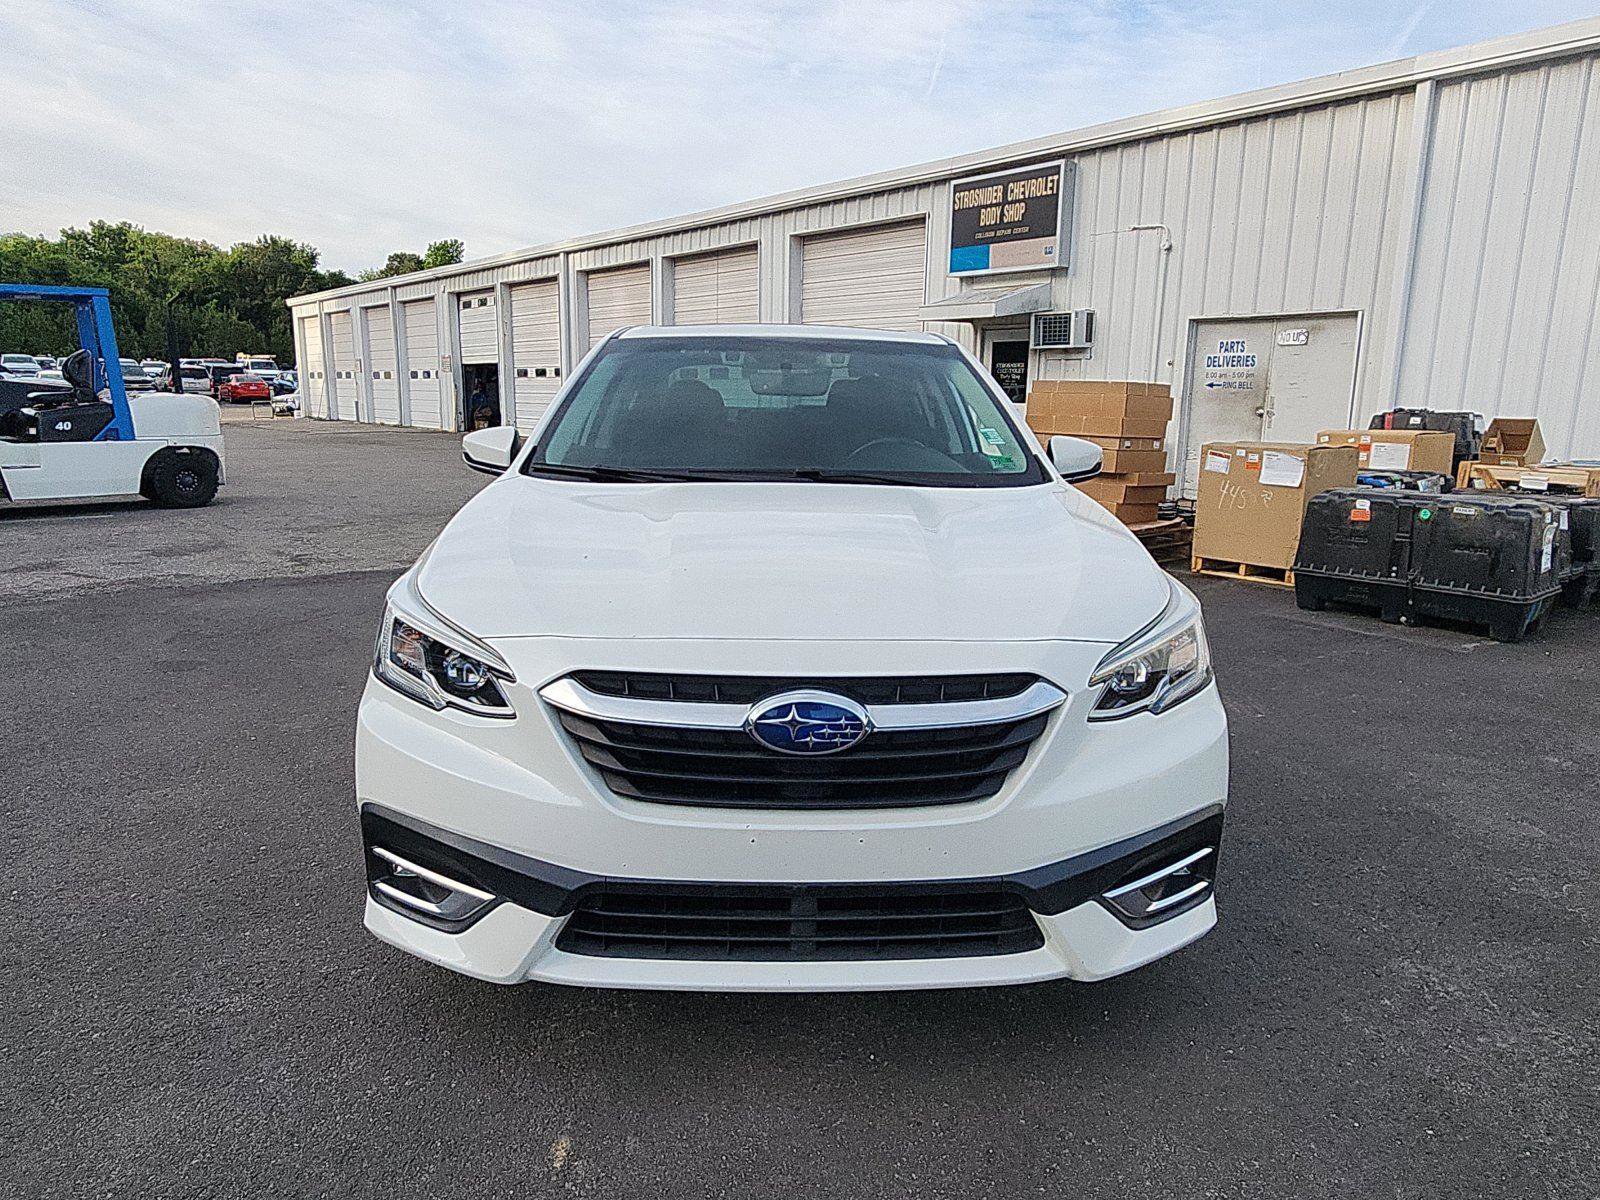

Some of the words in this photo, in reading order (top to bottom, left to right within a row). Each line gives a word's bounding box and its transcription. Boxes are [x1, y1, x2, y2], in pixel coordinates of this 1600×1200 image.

[954, 185, 1004, 211] STROSNIDER
[1007, 175, 1059, 202] CHEVROLET
[980, 205, 1002, 227] BODY
[1003, 202, 1026, 224] SHOP
[1219, 340, 1246, 354] PARTS
[1206, 354, 1256, 368] DELIVERIES
[1222, 381, 1237, 390] RING
[1238, 381, 1254, 390] BELL
[55, 421, 72, 431] 40
